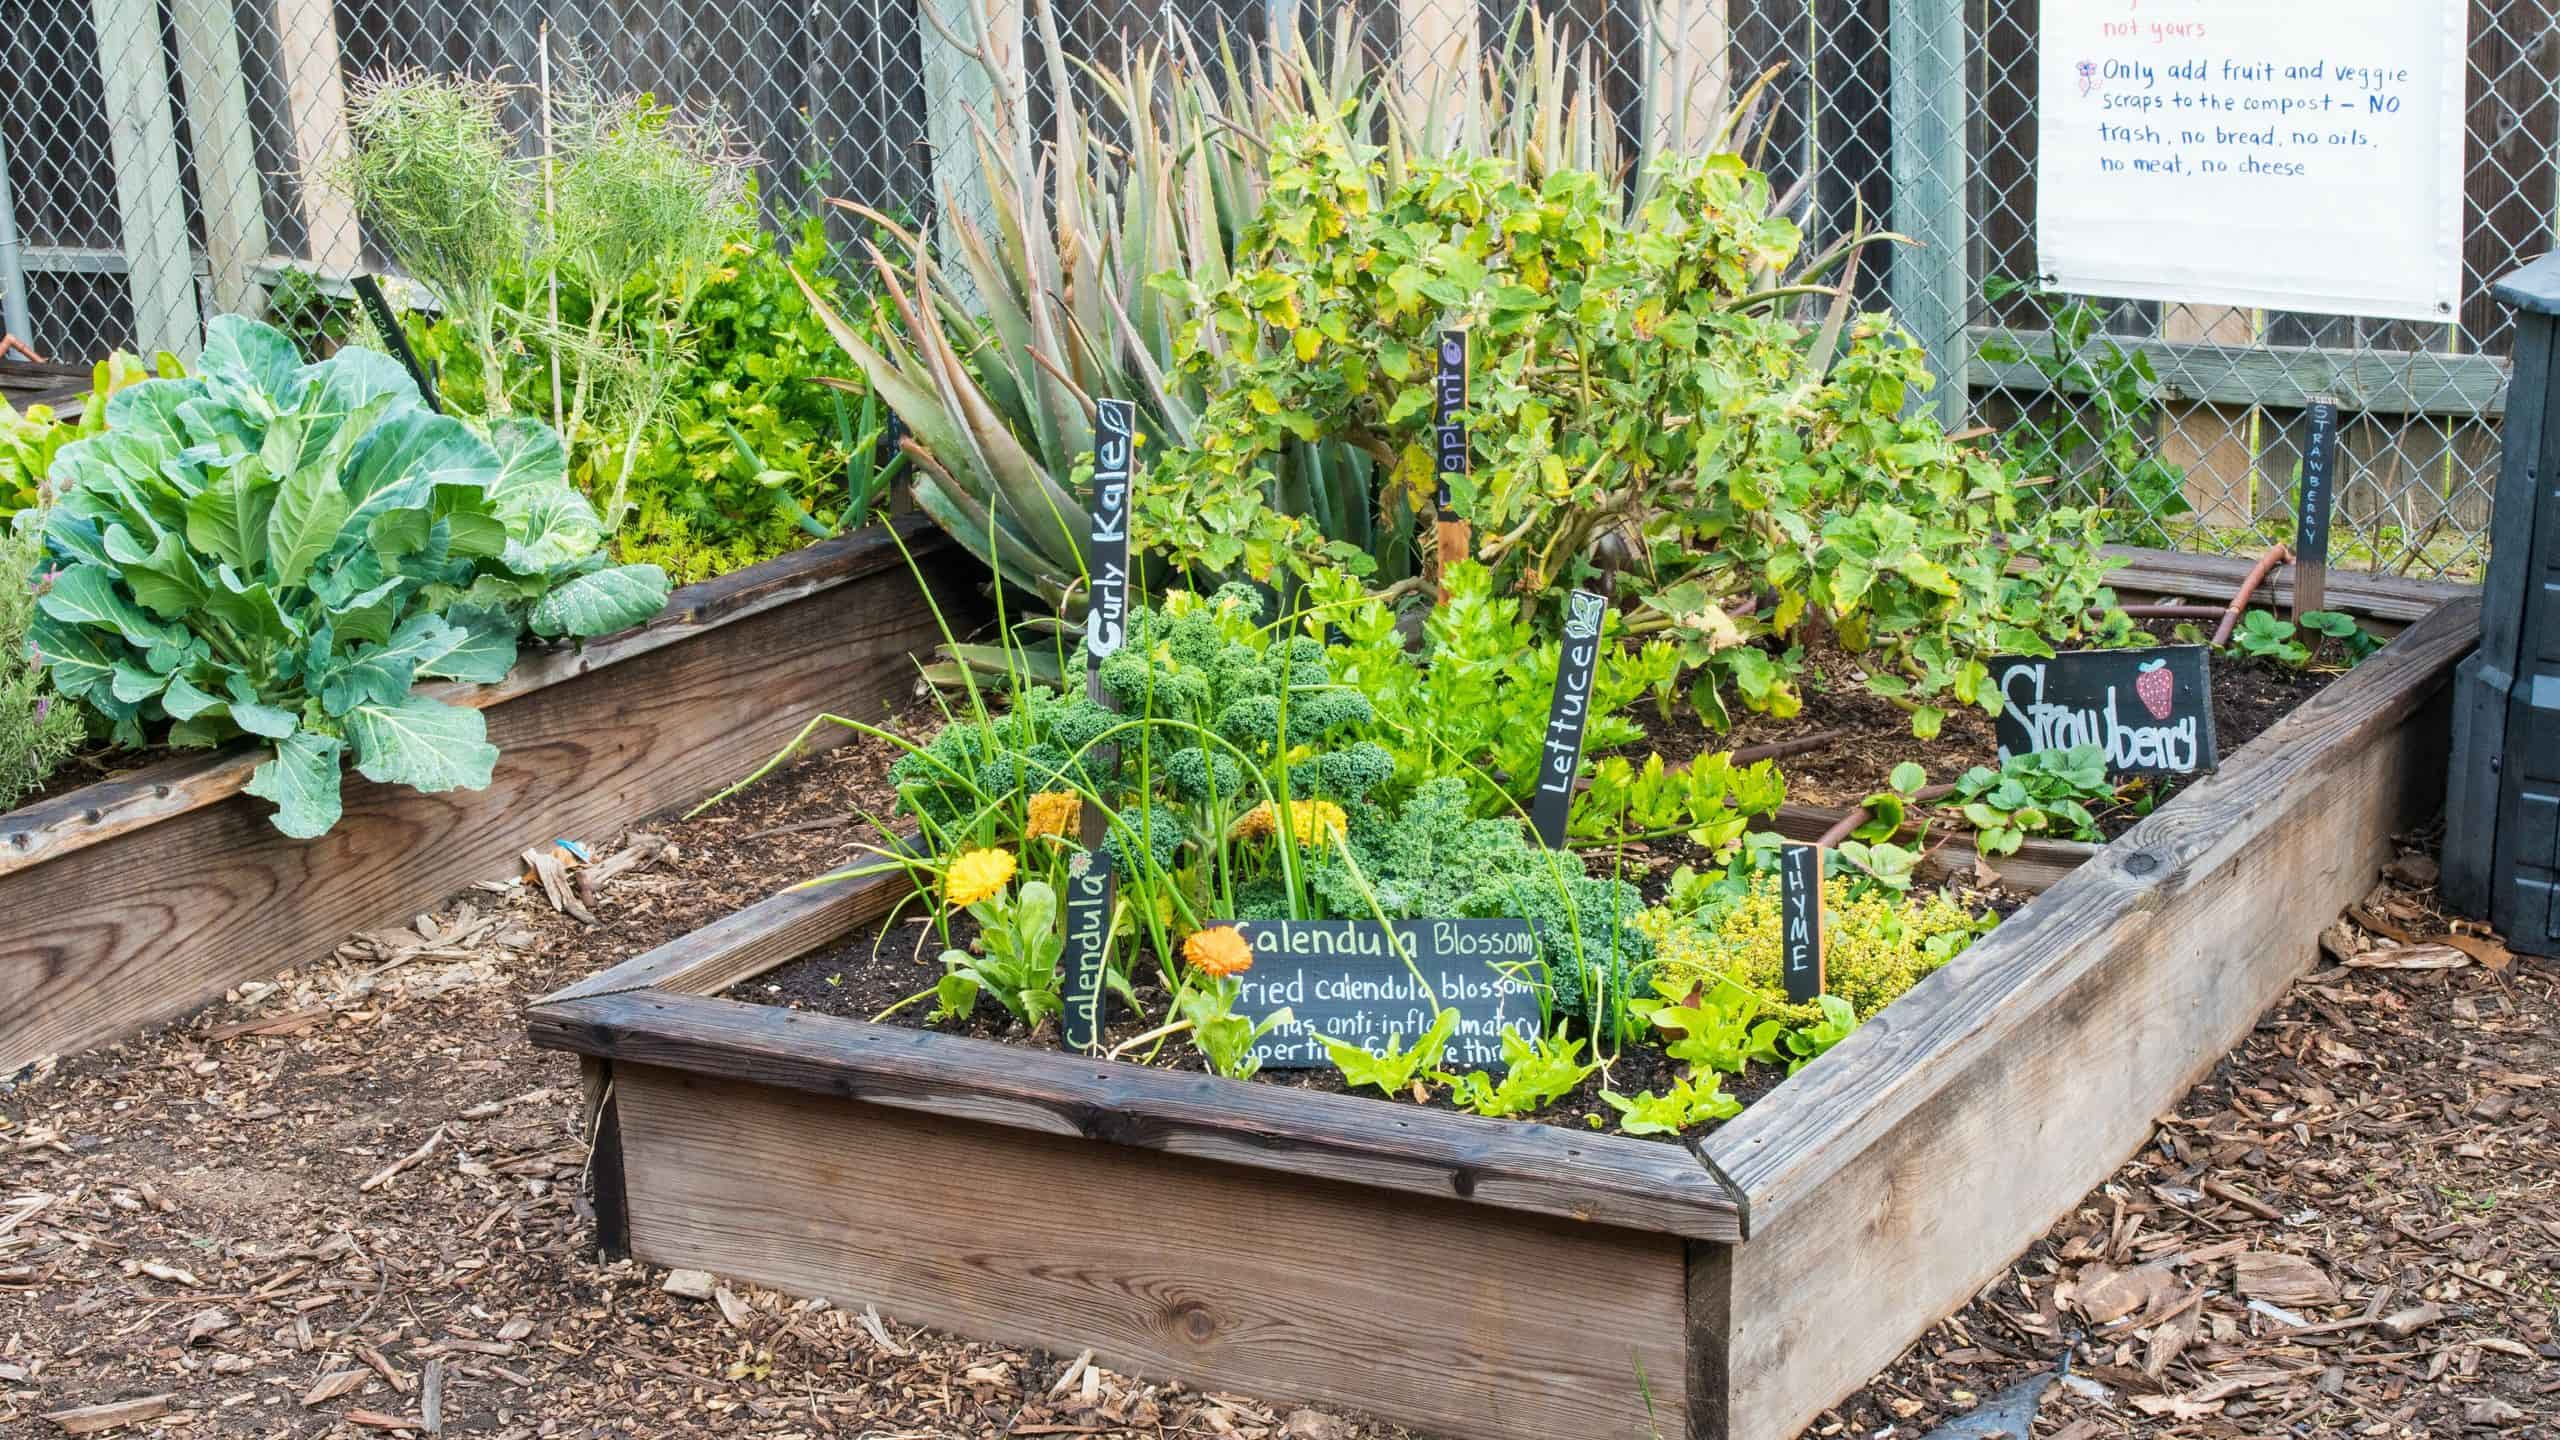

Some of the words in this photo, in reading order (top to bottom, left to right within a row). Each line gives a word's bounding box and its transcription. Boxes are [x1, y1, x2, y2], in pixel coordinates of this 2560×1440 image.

[2103, 19, 2137, 37] not
[2151, 22, 2206, 43] yours
[2103, 58, 2154, 89] Only
[2168, 58, 2207, 80] add
[2222, 58, 2275, 82] fruit
[2285, 59, 2323, 80] and
[2335, 65, 2408, 91] veggie
[2103, 92, 2163, 112] scraps
[2172, 91, 2192, 109] to
[2199, 92, 2235, 111] the
[2244, 94, 2333, 115] compost
[2369, 94, 2400, 113] NO
[2100, 156, 2124, 171] no
[2202, 158, 2227, 172] no
[2239, 154, 2305, 176] cheese
[2182, 131, 2205, 144] no
[2292, 132, 2318, 145] no
[1092, 435, 1127, 543] Kale
[2305, 405, 2330, 545] STRAWBERRY
[1087, 562, 1125, 657] Curly
[1542, 645, 1593, 794] Lettuce
[1787, 846, 1810, 972] THYME
[1066, 873, 1107, 1050] Calendula
[1228, 967, 1304, 1006] ried
